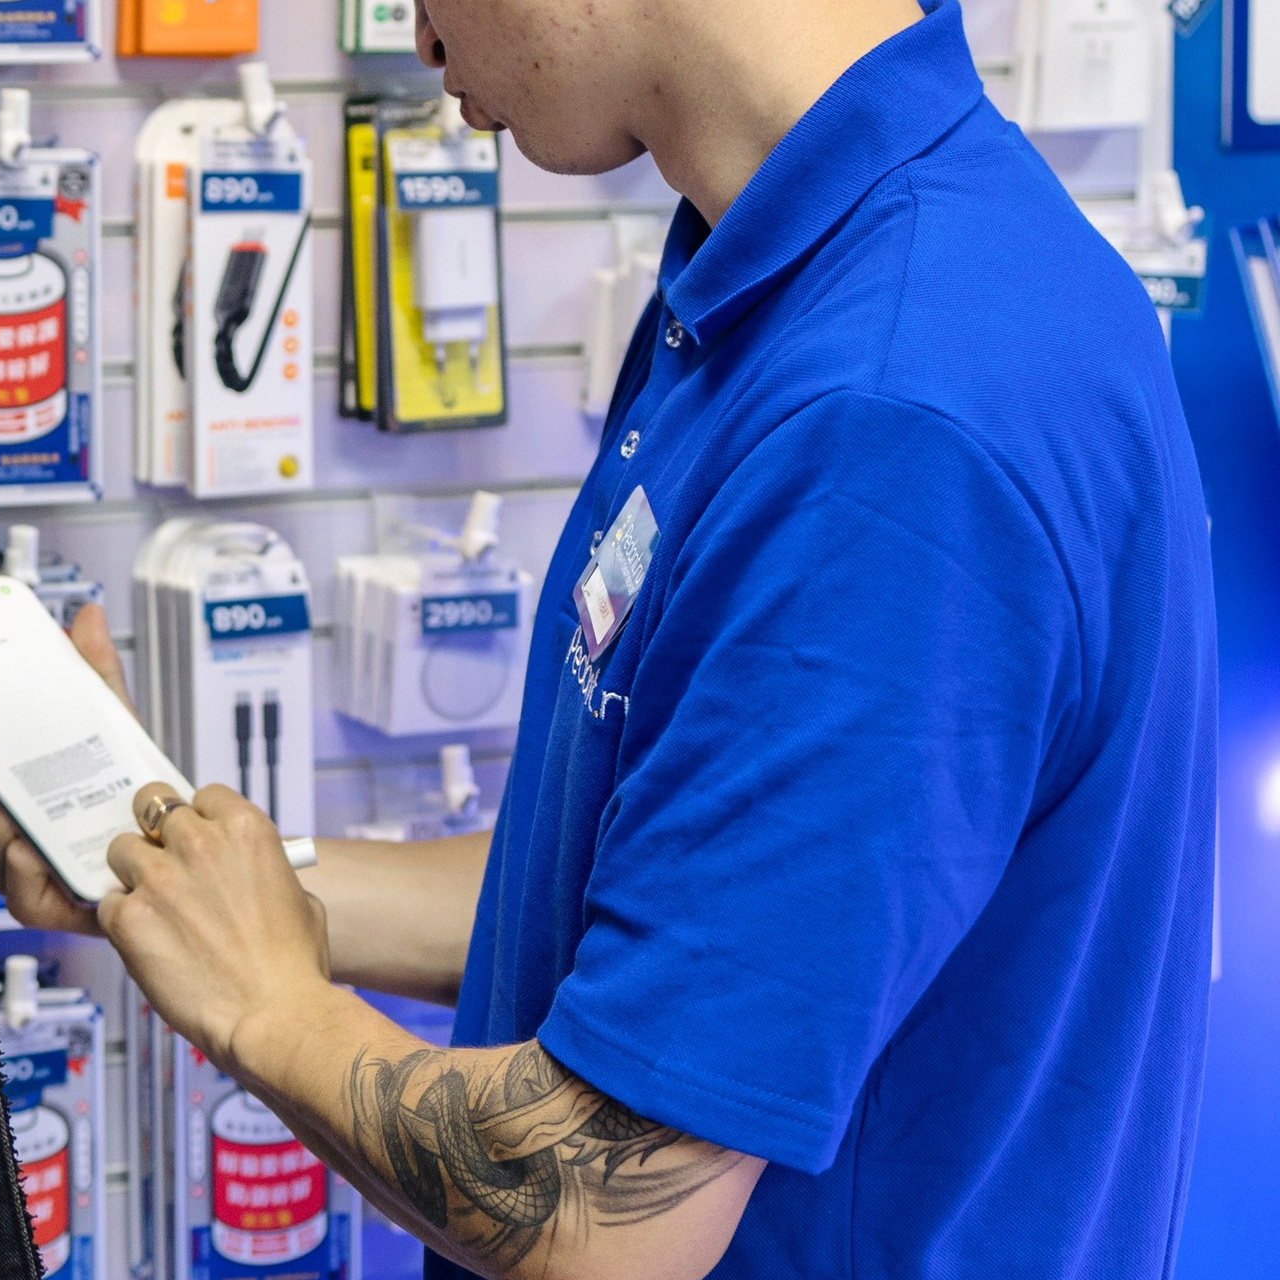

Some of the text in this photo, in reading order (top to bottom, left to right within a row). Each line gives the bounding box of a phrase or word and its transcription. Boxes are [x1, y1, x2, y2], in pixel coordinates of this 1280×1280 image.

[205, 176, 258, 204] 890
[400, 175, 465, 203] 1590
[211, 603, 266, 632] 890
[425, 599, 494, 629] 2990
